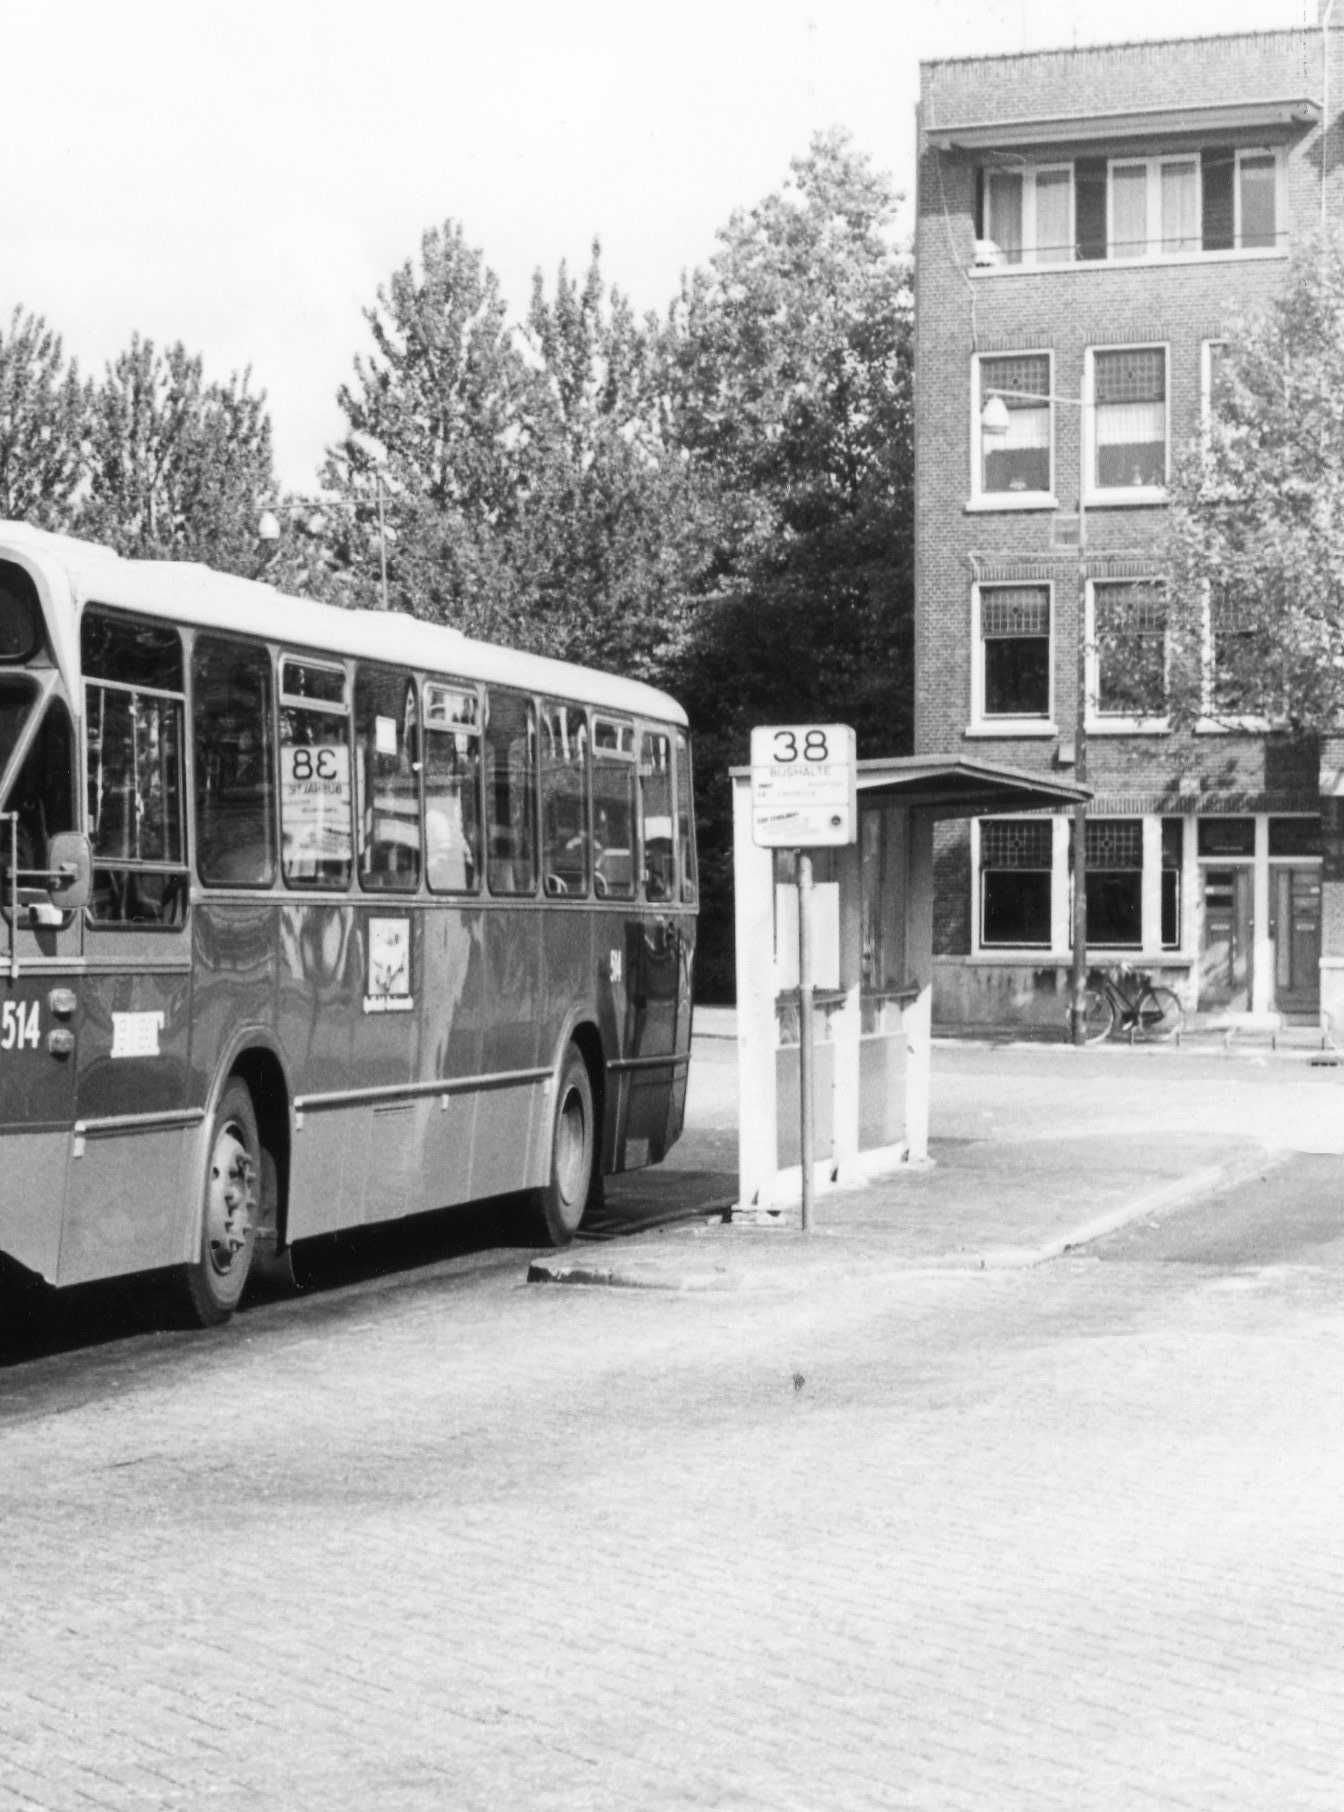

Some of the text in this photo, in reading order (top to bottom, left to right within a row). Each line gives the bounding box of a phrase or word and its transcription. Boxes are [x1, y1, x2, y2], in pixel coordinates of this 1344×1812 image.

[773, 729, 829, 762] 38
[770, 765, 832, 777] BUSHALTE
[0, 1000, 41, 1051] 514
